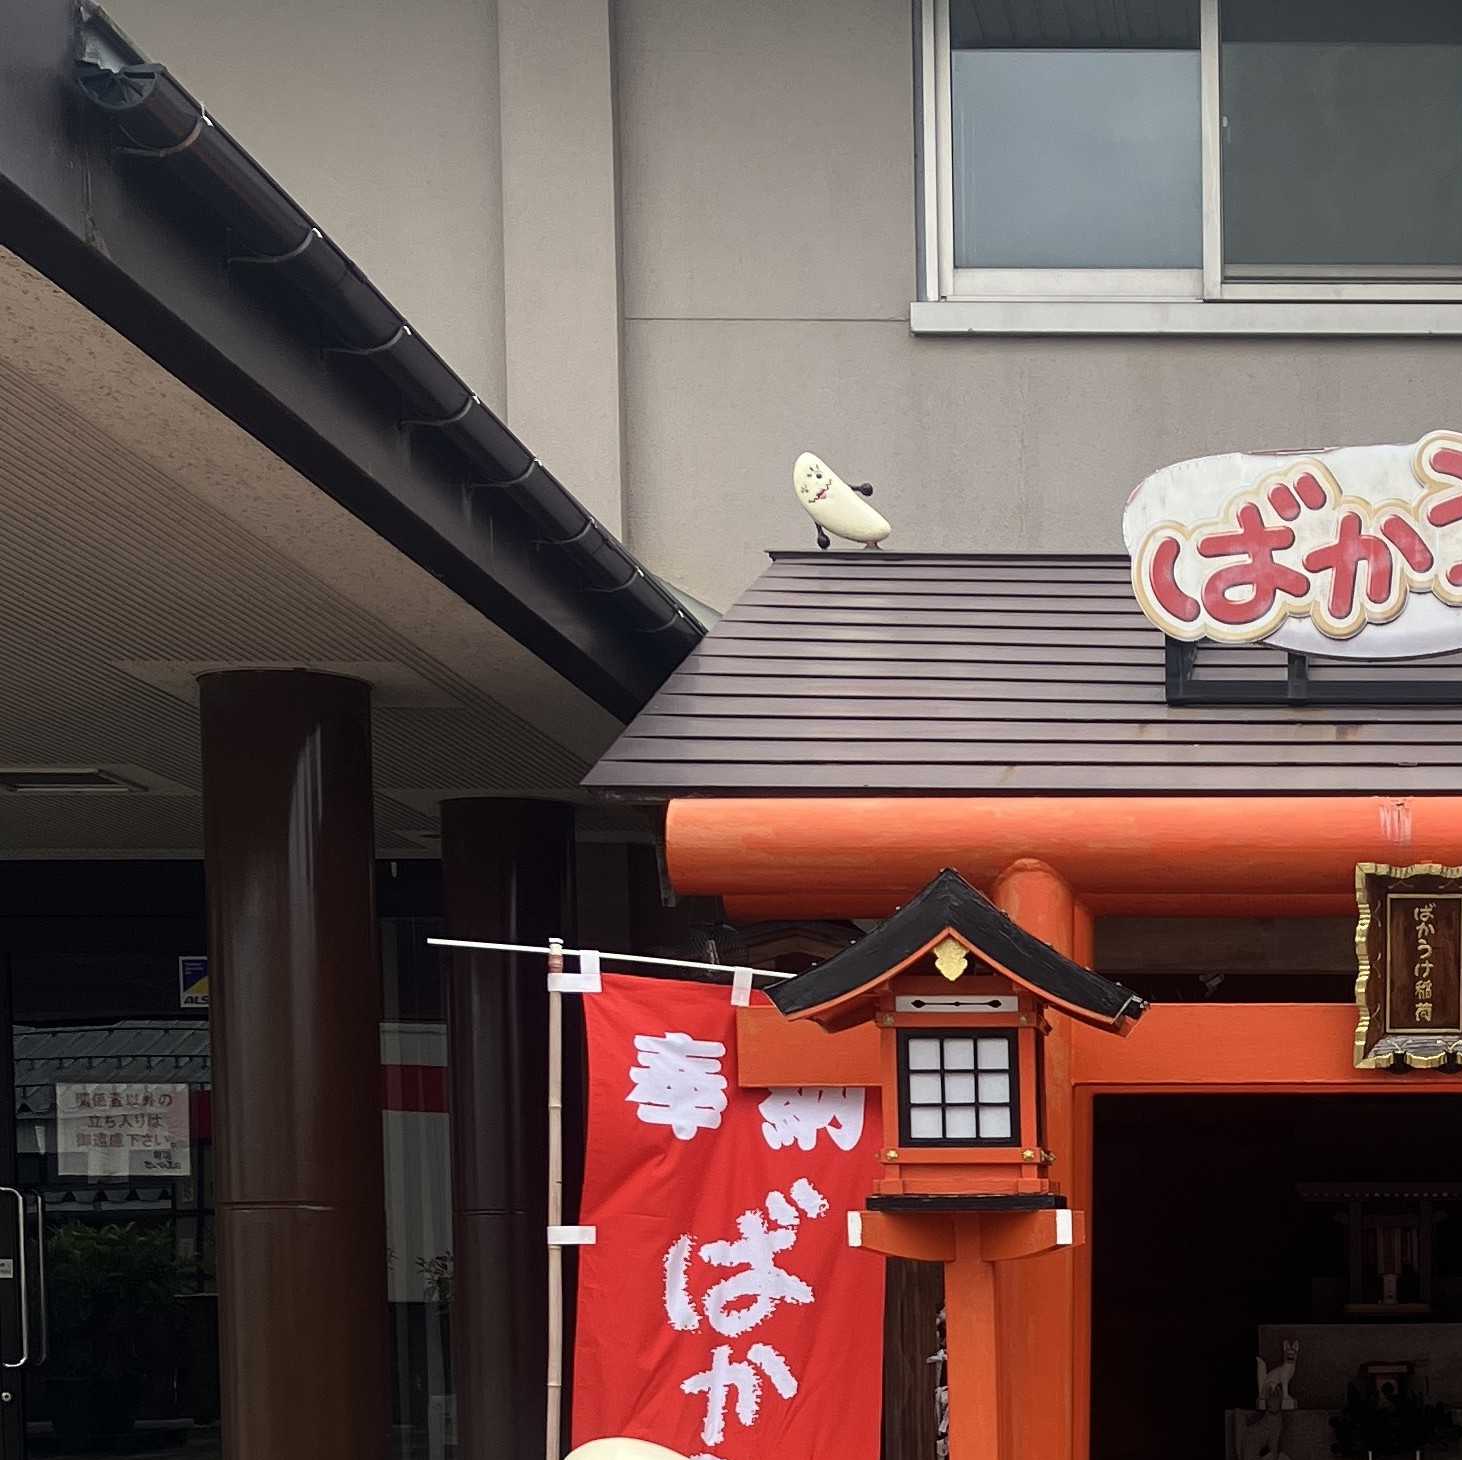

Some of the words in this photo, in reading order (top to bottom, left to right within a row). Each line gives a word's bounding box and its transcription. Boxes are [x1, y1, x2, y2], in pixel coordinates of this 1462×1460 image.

[1413, 902, 1437, 1022] ばかうけ稲荷
